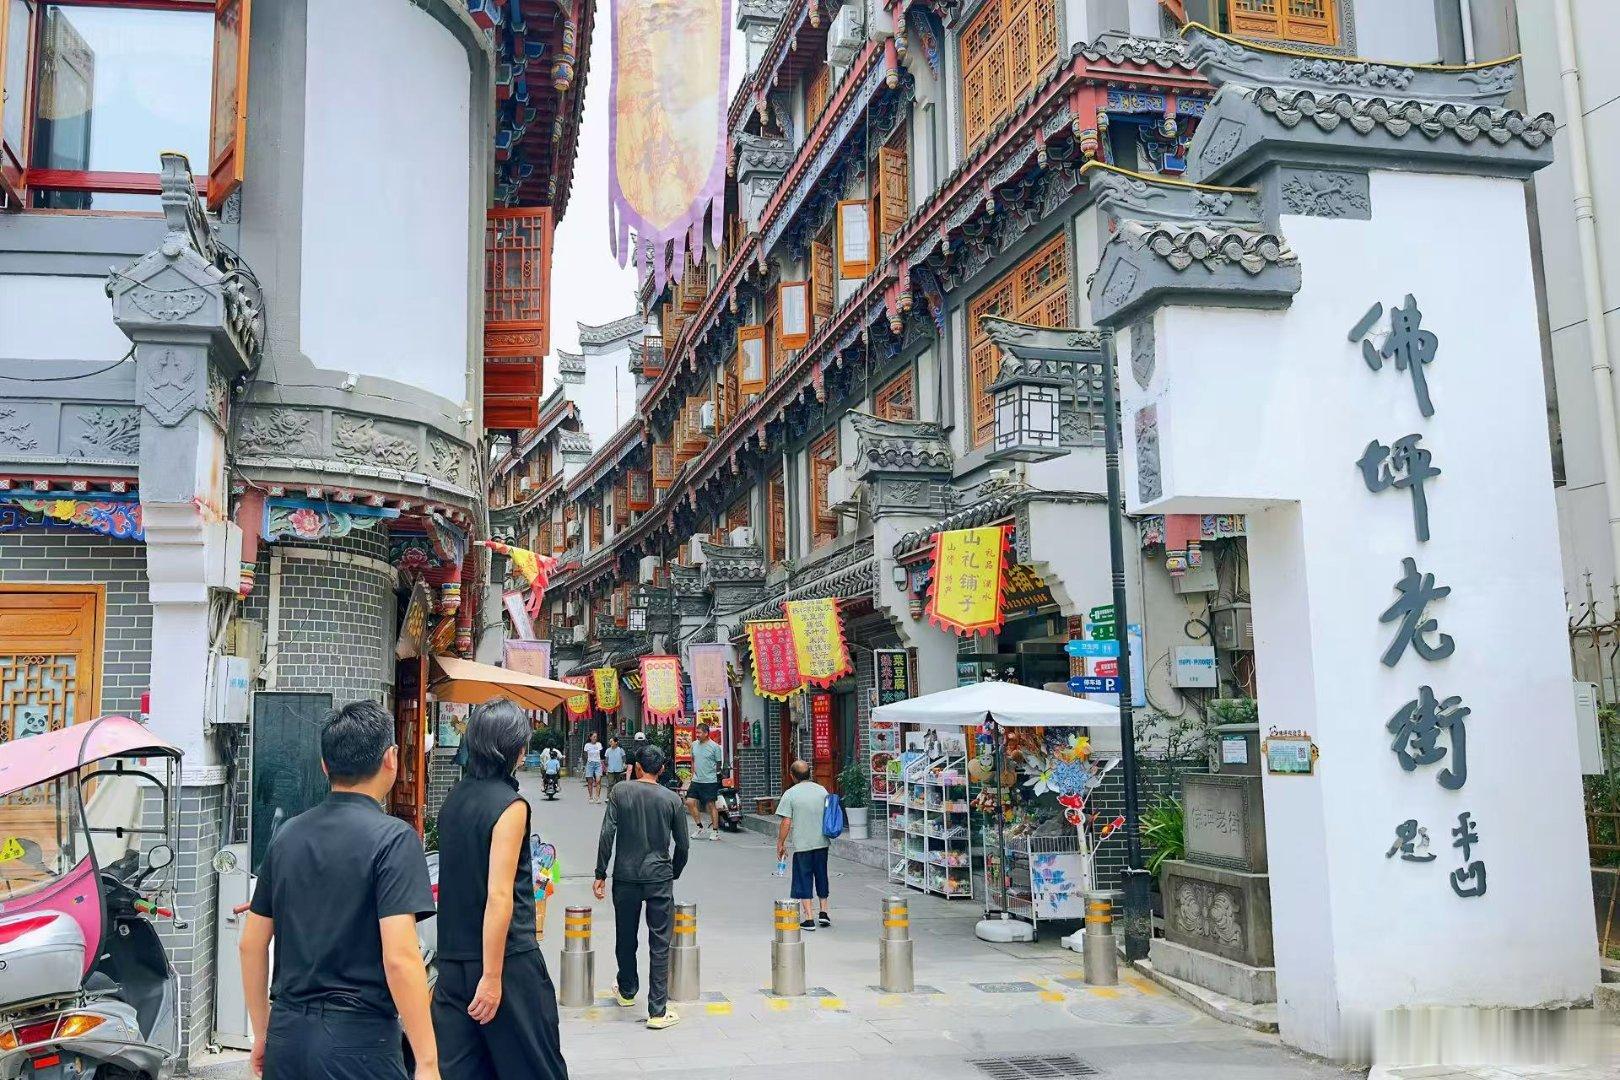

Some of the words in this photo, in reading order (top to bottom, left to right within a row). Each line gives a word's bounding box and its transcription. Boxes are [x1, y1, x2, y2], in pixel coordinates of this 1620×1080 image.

[1348, 293, 1470, 790] 佛坪老街
[1105, 678, 1115, 691] P
